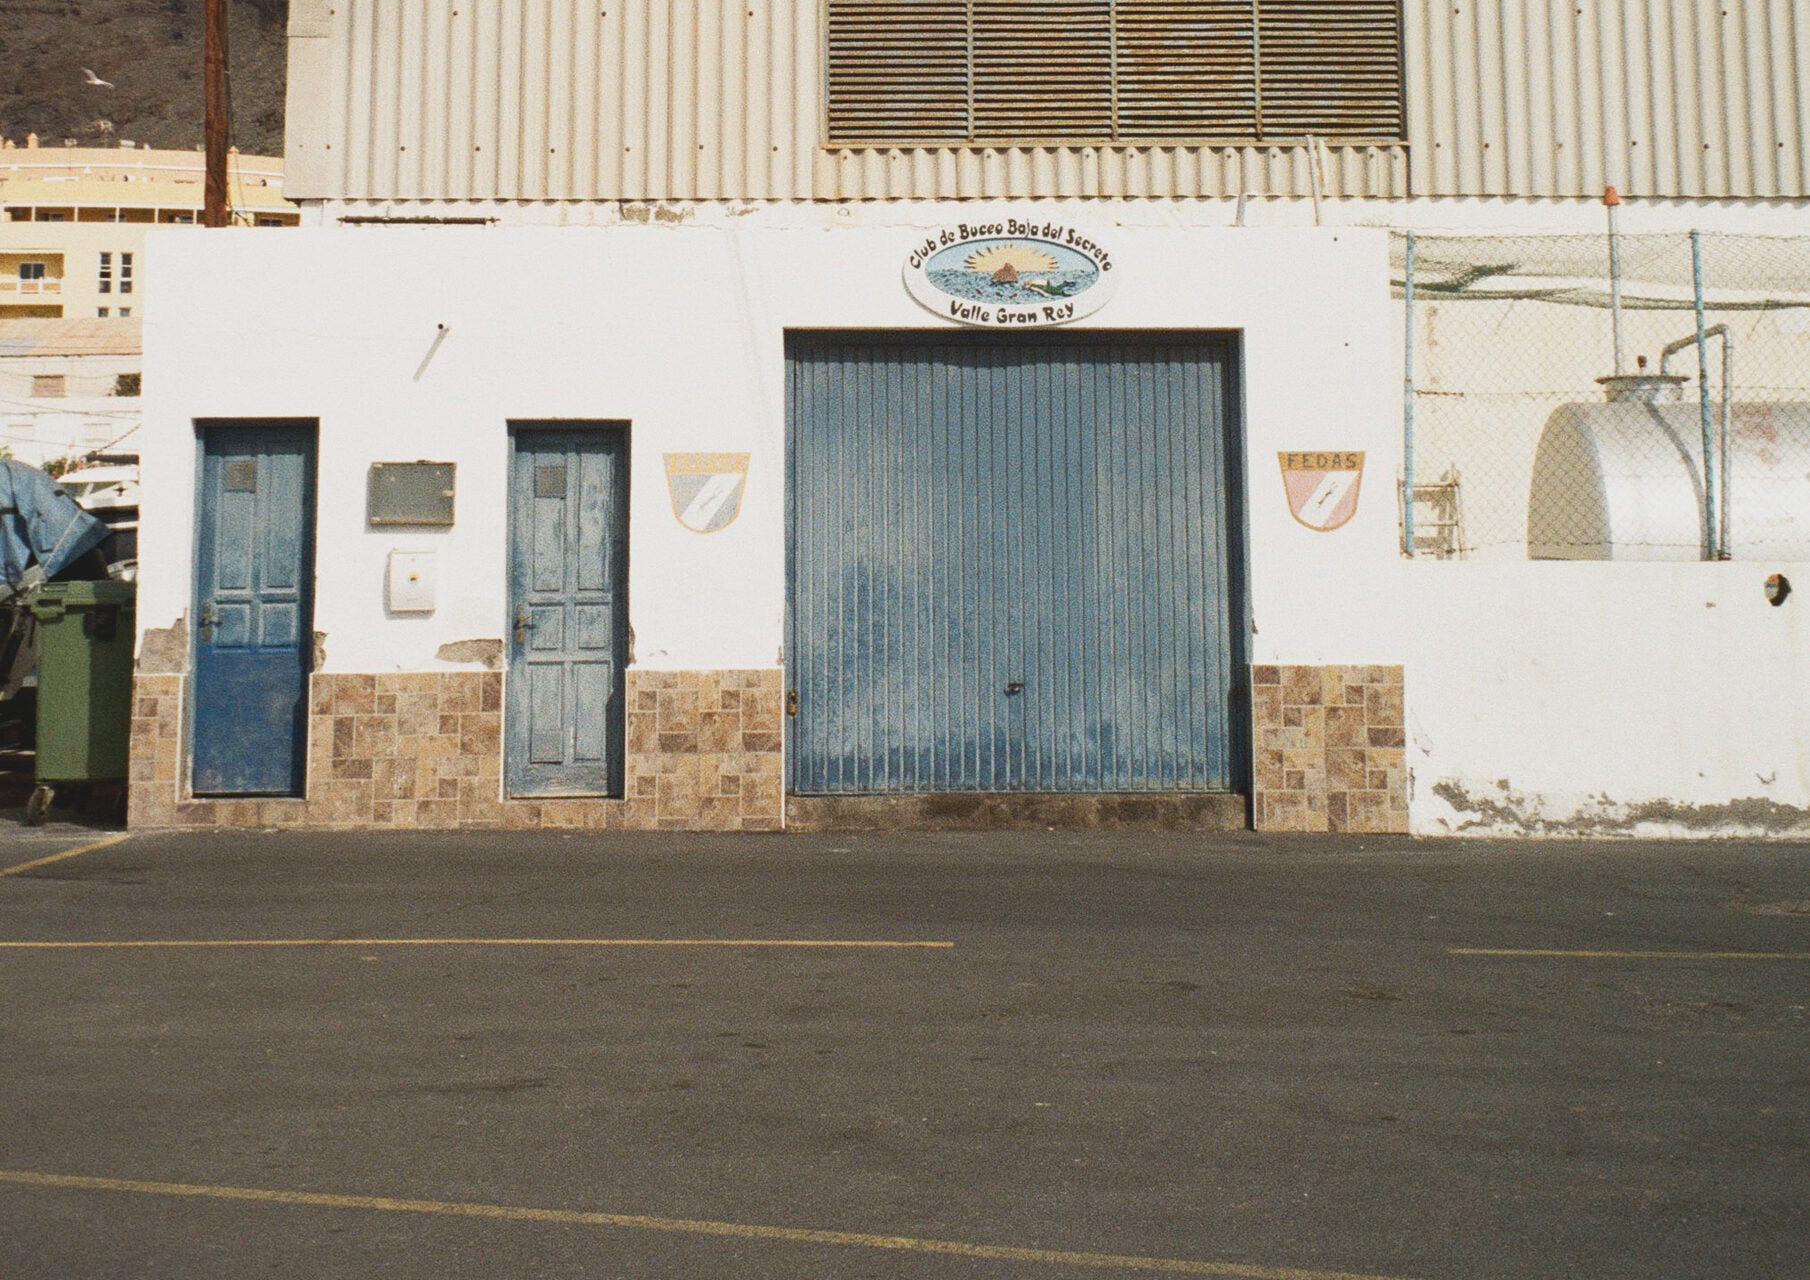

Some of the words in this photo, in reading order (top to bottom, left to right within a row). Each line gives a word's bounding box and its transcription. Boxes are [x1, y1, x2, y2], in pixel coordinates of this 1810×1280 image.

[909, 238, 937, 270] Club
[940, 228, 956, 246] de
[958, 223, 1004, 240] Buceo
[1007, 218, 1039, 239] Baja
[1042, 222, 1064, 241] del
[1065, 228, 1113, 272] Secreto
[950, 300, 990, 322] Valle
[997, 307, 1038, 324] Gran
[1042, 302, 1074, 322] Rey
[1286, 453, 1358, 469] FEDAS
